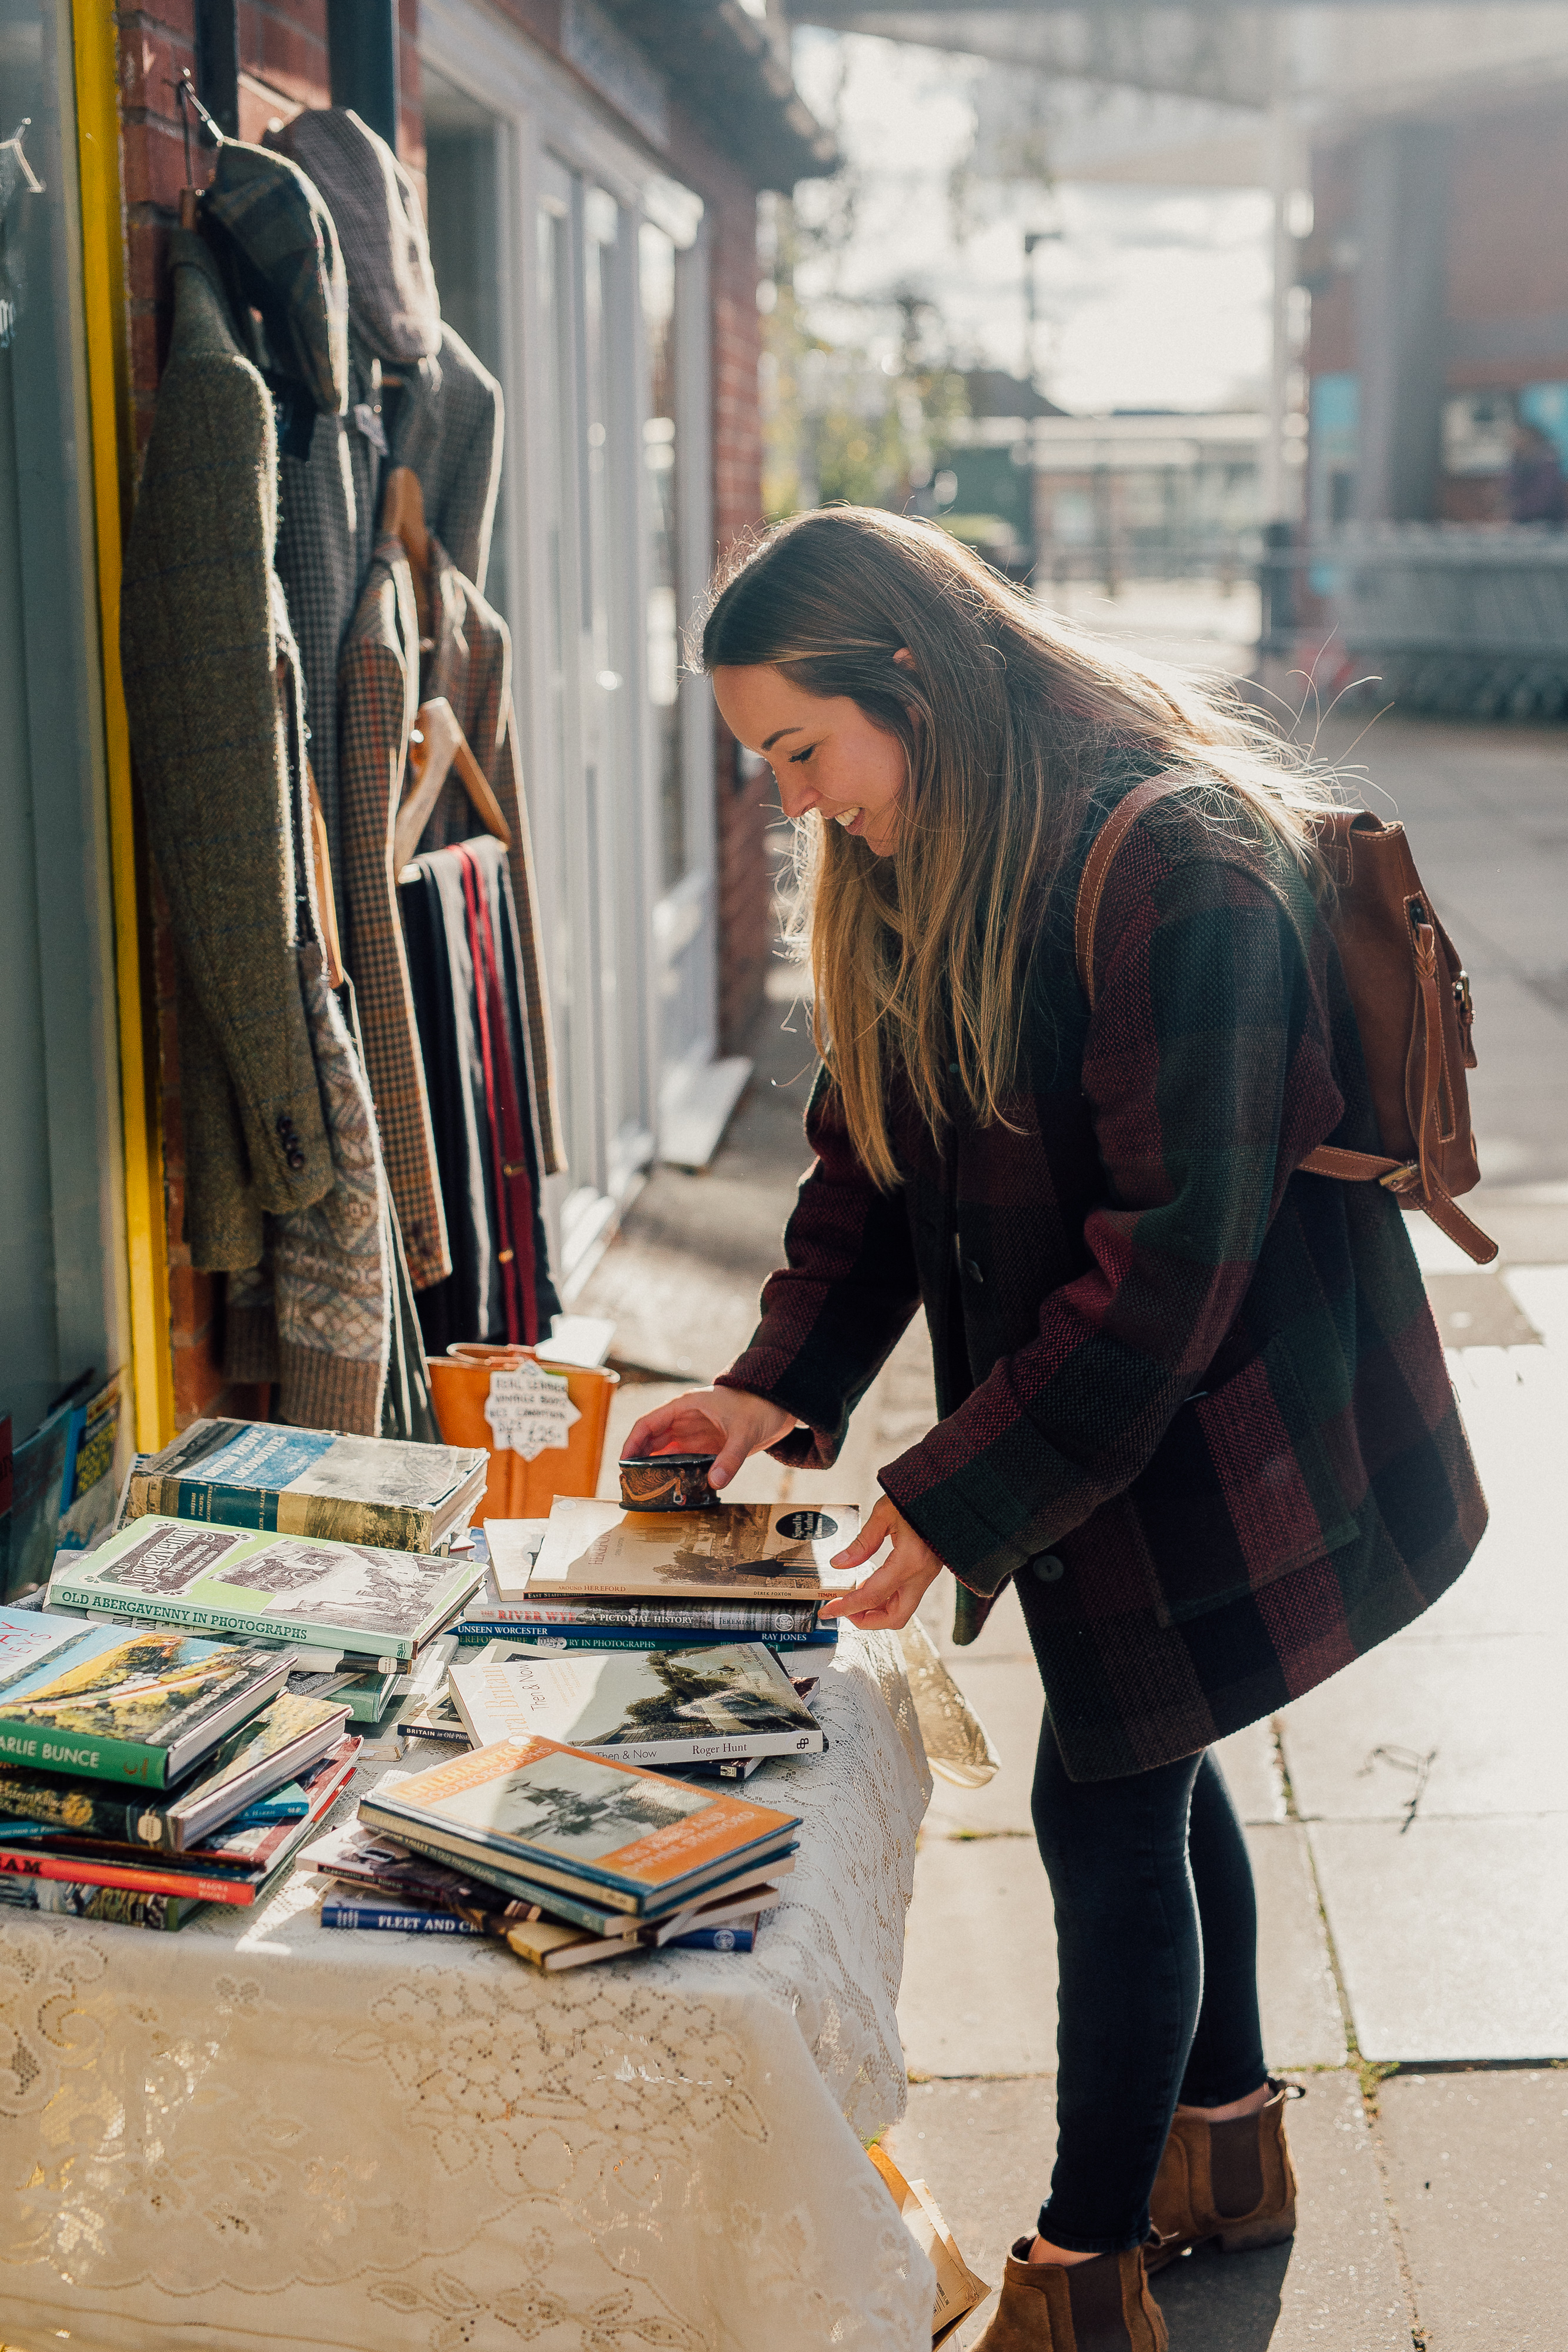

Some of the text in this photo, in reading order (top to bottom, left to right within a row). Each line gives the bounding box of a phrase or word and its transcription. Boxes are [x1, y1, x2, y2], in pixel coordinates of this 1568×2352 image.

[202, 1429, 266, 1478] BRITISH PACIFIC
[230, 1435, 287, 1479] LOCOMOTIVES
[793, 1522, 805, 1538] Signed
[804, 1513, 814, 1531] Author
[117, 1527, 215, 1592] Abergavenny
[170, 1544, 209, 1572] PHOTOGRAPHS
[111, 1562, 131, 1574] OLD
[62, 1591, 89, 1605] OLD
[92, 1596, 190, 1621] ABERGAVENNY
[193, 1612, 209, 1623] IN
[211, 1615, 307, 1639] PHOTOGRAPHS
[498, 1609, 541, 1621] RIVER
[545, 1611, 576, 1622] WYE
[600, 1614, 650, 1623] PICTORIAL
[654, 1615, 694, 1624] HISTORY
[718, 1616, 755, 1625] JEREMIAH
[494, 1626, 548, 1635] WORCESTER
[761, 1633, 807, 1642] RAY JONES
[594, 1639, 656, 1649] PHOTOGRAPHS
[516, 1663, 536, 1682] Now
[182, 1693, 221, 1715] MICHAEL
[211, 1671, 249, 1693] PORTILLO
[481, 1664, 520, 1709] Britain
[530, 1691, 549, 1711] Then
[406, 1728, 435, 1736] BRITAIN
[42, 1743, 100, 1768] BUNCE
[622, 1750, 630, 1760] &
[633, 1749, 657, 1759] Now
[692, 1744, 720, 1756] Roger
[723, 1743, 747, 1753] Hunt
[455, 1746, 553, 1786] PHOTOGRAPHS
[378, 1915, 420, 1930] FLEET
[424, 1918, 456, 1932] AND
